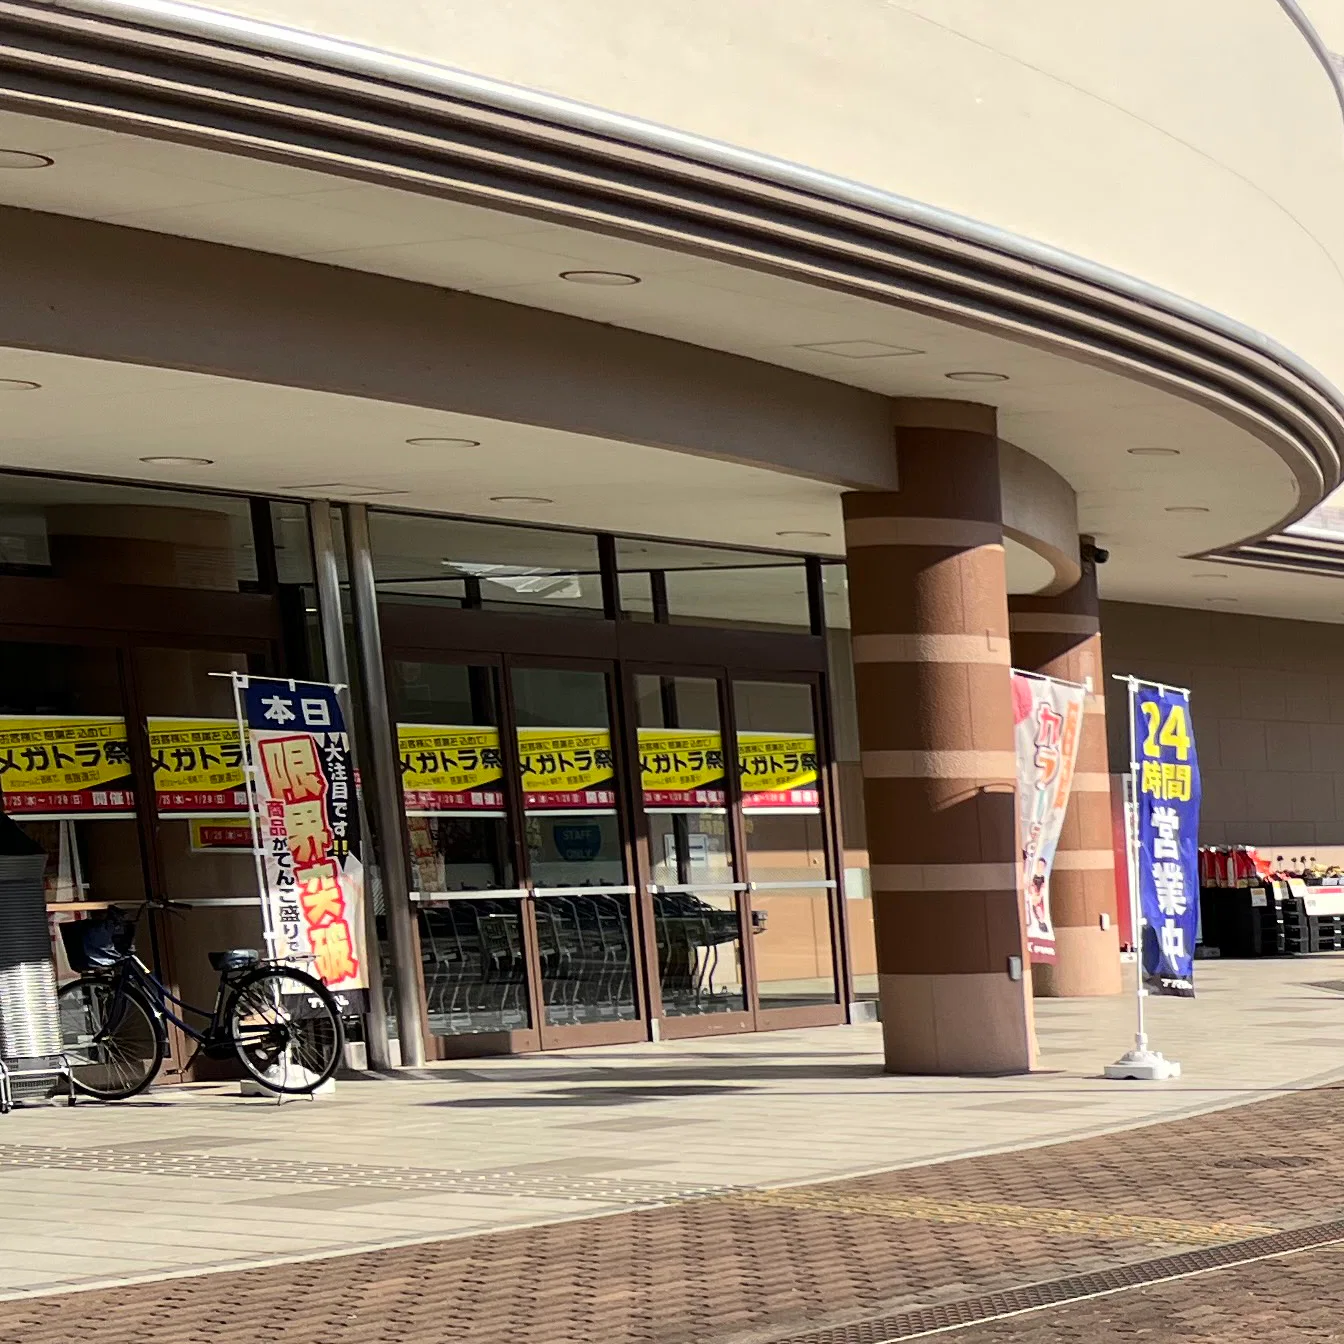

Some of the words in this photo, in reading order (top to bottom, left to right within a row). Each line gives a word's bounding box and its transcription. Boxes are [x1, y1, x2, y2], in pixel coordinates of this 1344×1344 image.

[260, 695, 331, 725] 本日
[1140, 702, 1190, 761] 24
[0, 740, 132, 774] メガトラ祭
[150, 742, 252, 773] メガトラ
[399, 748, 502, 775] メガトラ祭
[519, 749, 613, 775] メガトラ祭
[639, 750, 723, 775] メガトラ祭
[738, 752, 818, 776] メガトラ祭
[1142, 760, 1192, 802] 時間
[323, 742, 350, 856] 大注目です!!
[257, 734, 360, 987] 限界突破
[1150, 806, 1187, 971] 営業中
